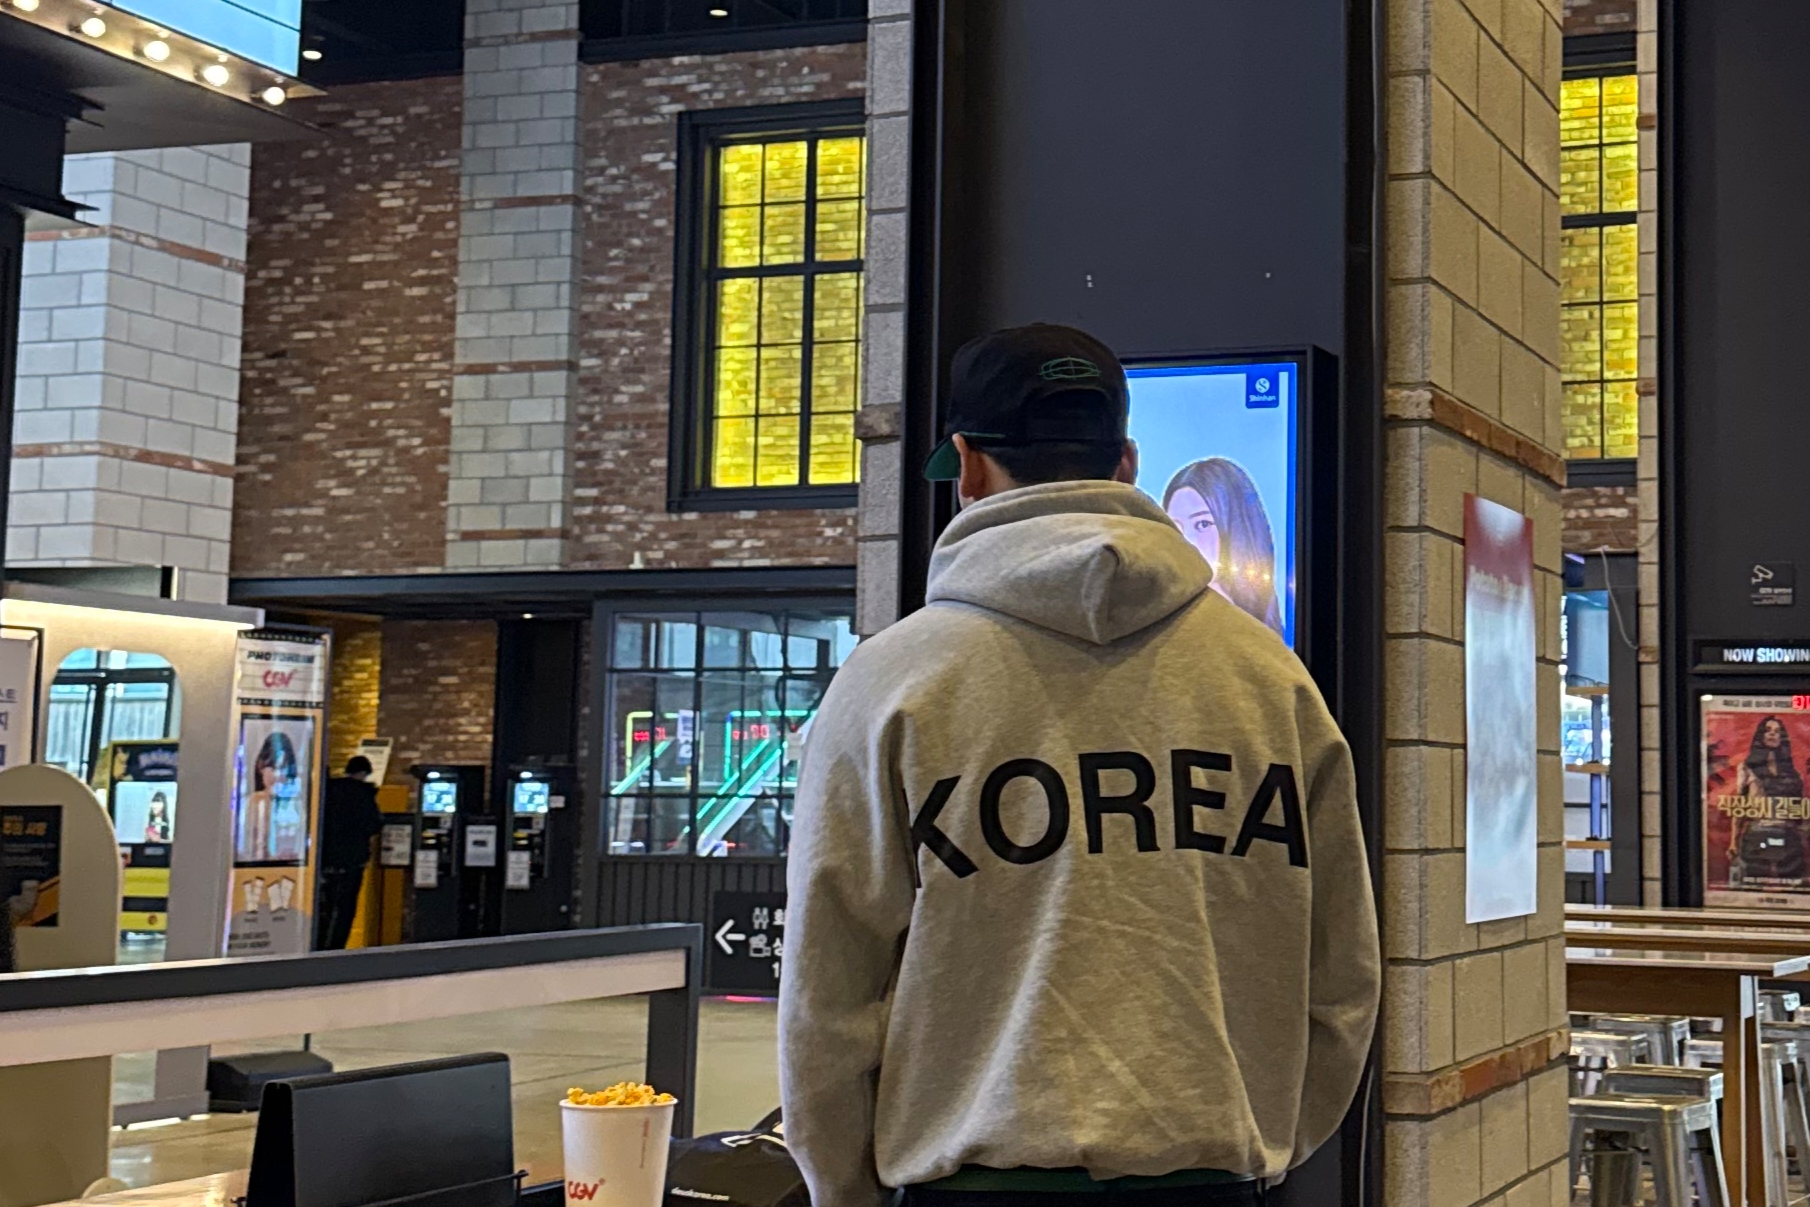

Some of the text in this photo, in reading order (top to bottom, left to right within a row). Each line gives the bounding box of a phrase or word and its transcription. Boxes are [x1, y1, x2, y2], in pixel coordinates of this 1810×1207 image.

[1723, 648, 1754, 662] NOW
[1718, 795, 1772, 819] 직장상사
[902, 749, 1308, 889] KOREA
[567, 1180, 599, 1201] CGV
